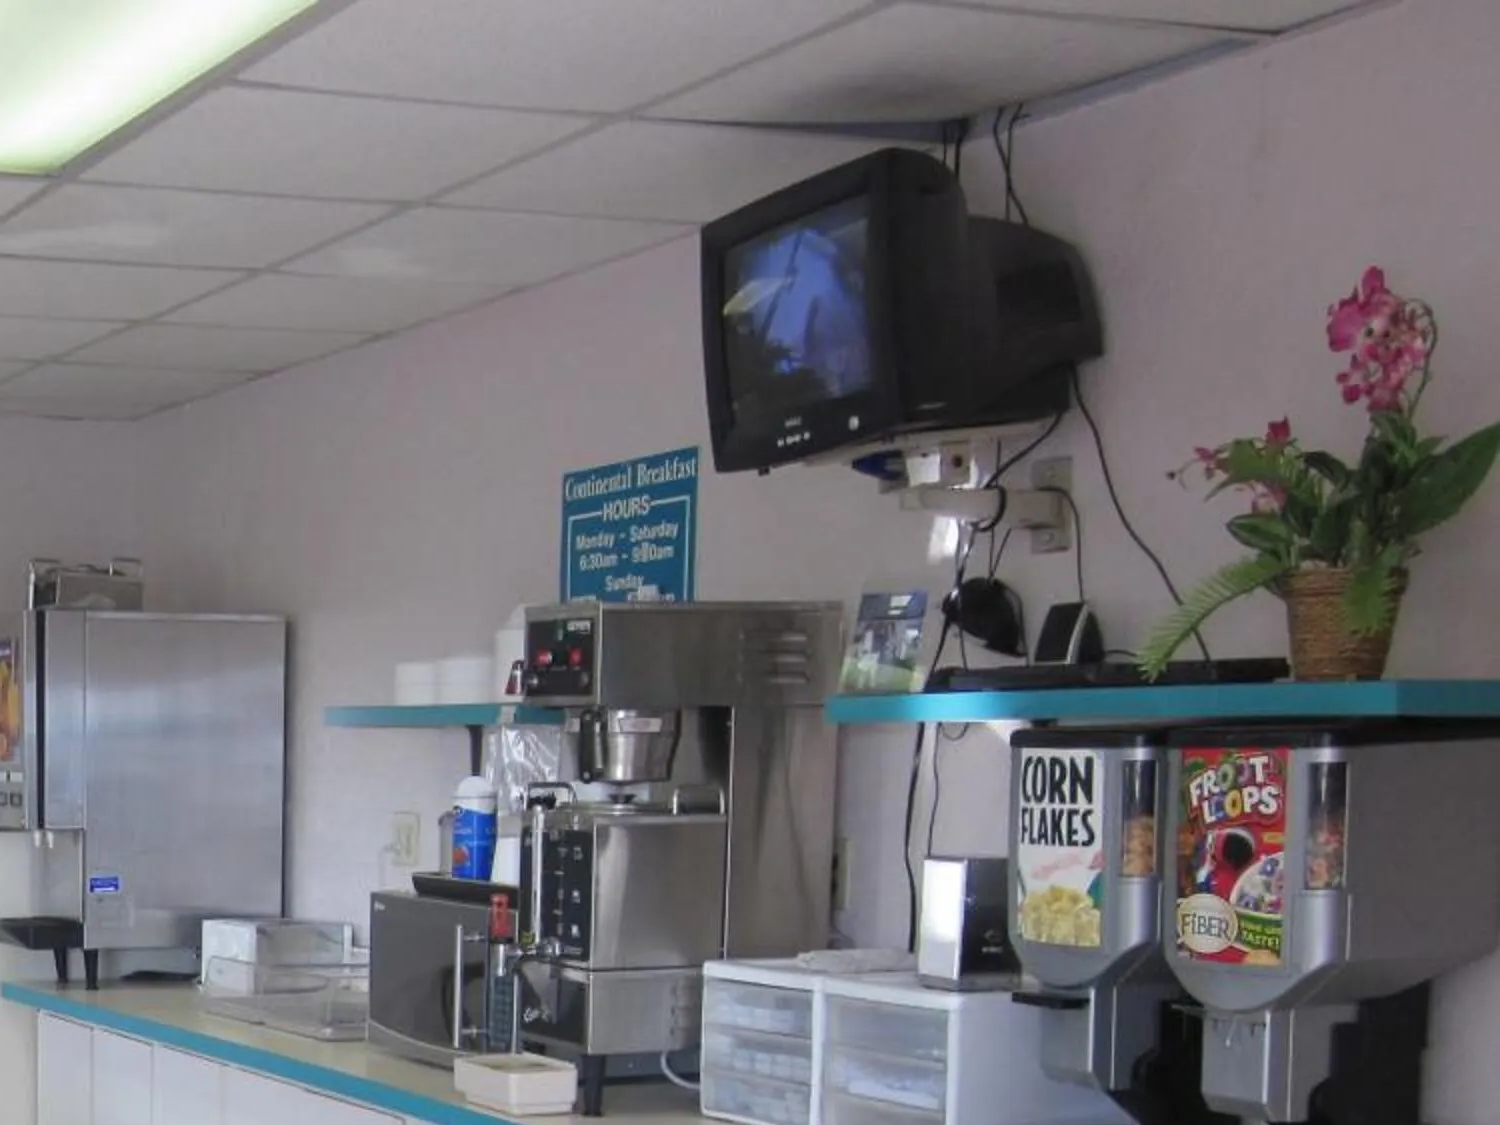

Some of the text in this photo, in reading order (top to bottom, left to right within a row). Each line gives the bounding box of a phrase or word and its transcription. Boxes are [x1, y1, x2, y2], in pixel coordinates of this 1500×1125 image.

[566, 457, 696, 499] Continental Breakfast
[603, 495, 651, 521] HOURS
[576, 531, 615, 549] Monday
[630, 520, 679, 542] Saturday
[605, 574, 644, 592] Sunday
[1022, 756, 1094, 805] CORN
[1021, 808, 1095, 847] FLAKES
